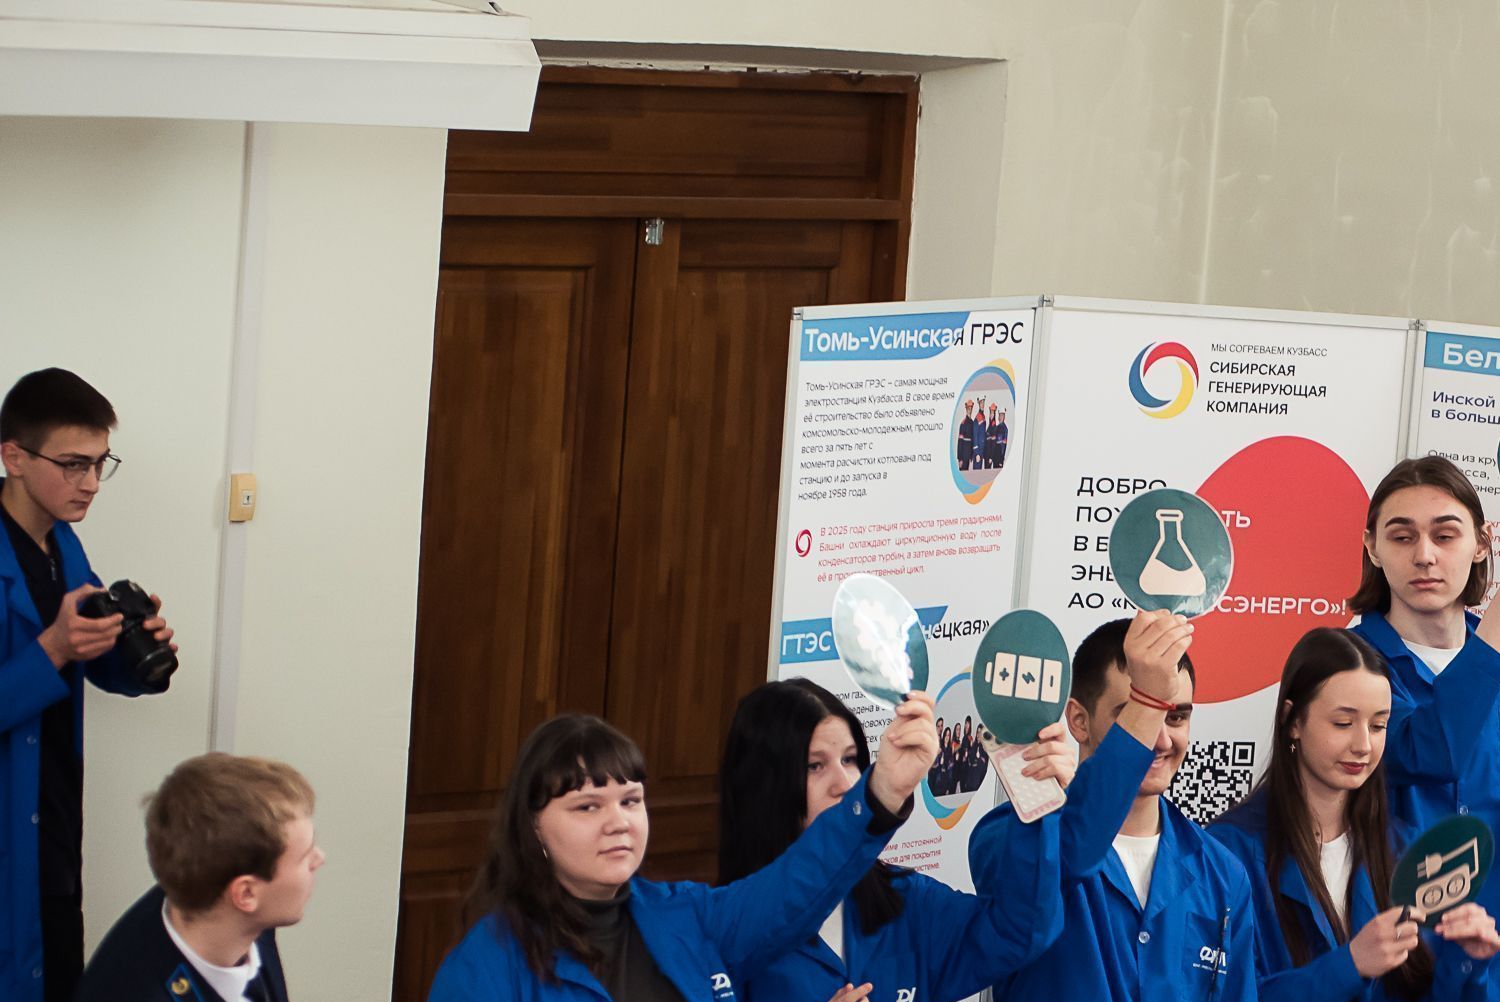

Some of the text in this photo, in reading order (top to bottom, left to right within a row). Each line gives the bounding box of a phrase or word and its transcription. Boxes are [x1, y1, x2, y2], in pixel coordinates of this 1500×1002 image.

[1211, 343, 1327, 357] МЫ СОГРЕВАЕМ КУЗБАСС
[1210, 361, 1295, 376] СИБИРСКАЯ
[1208, 380, 1326, 398] ГЕНЕРИРУЮЩАЯ
[1206, 400, 1288, 414] КОМПАНИЯ
[1433, 391, 1495, 408] Инской
[1431, 409, 1441, 418] в
[1073, 535, 1089, 551] В
[1067, 592, 1104, 609] АО
